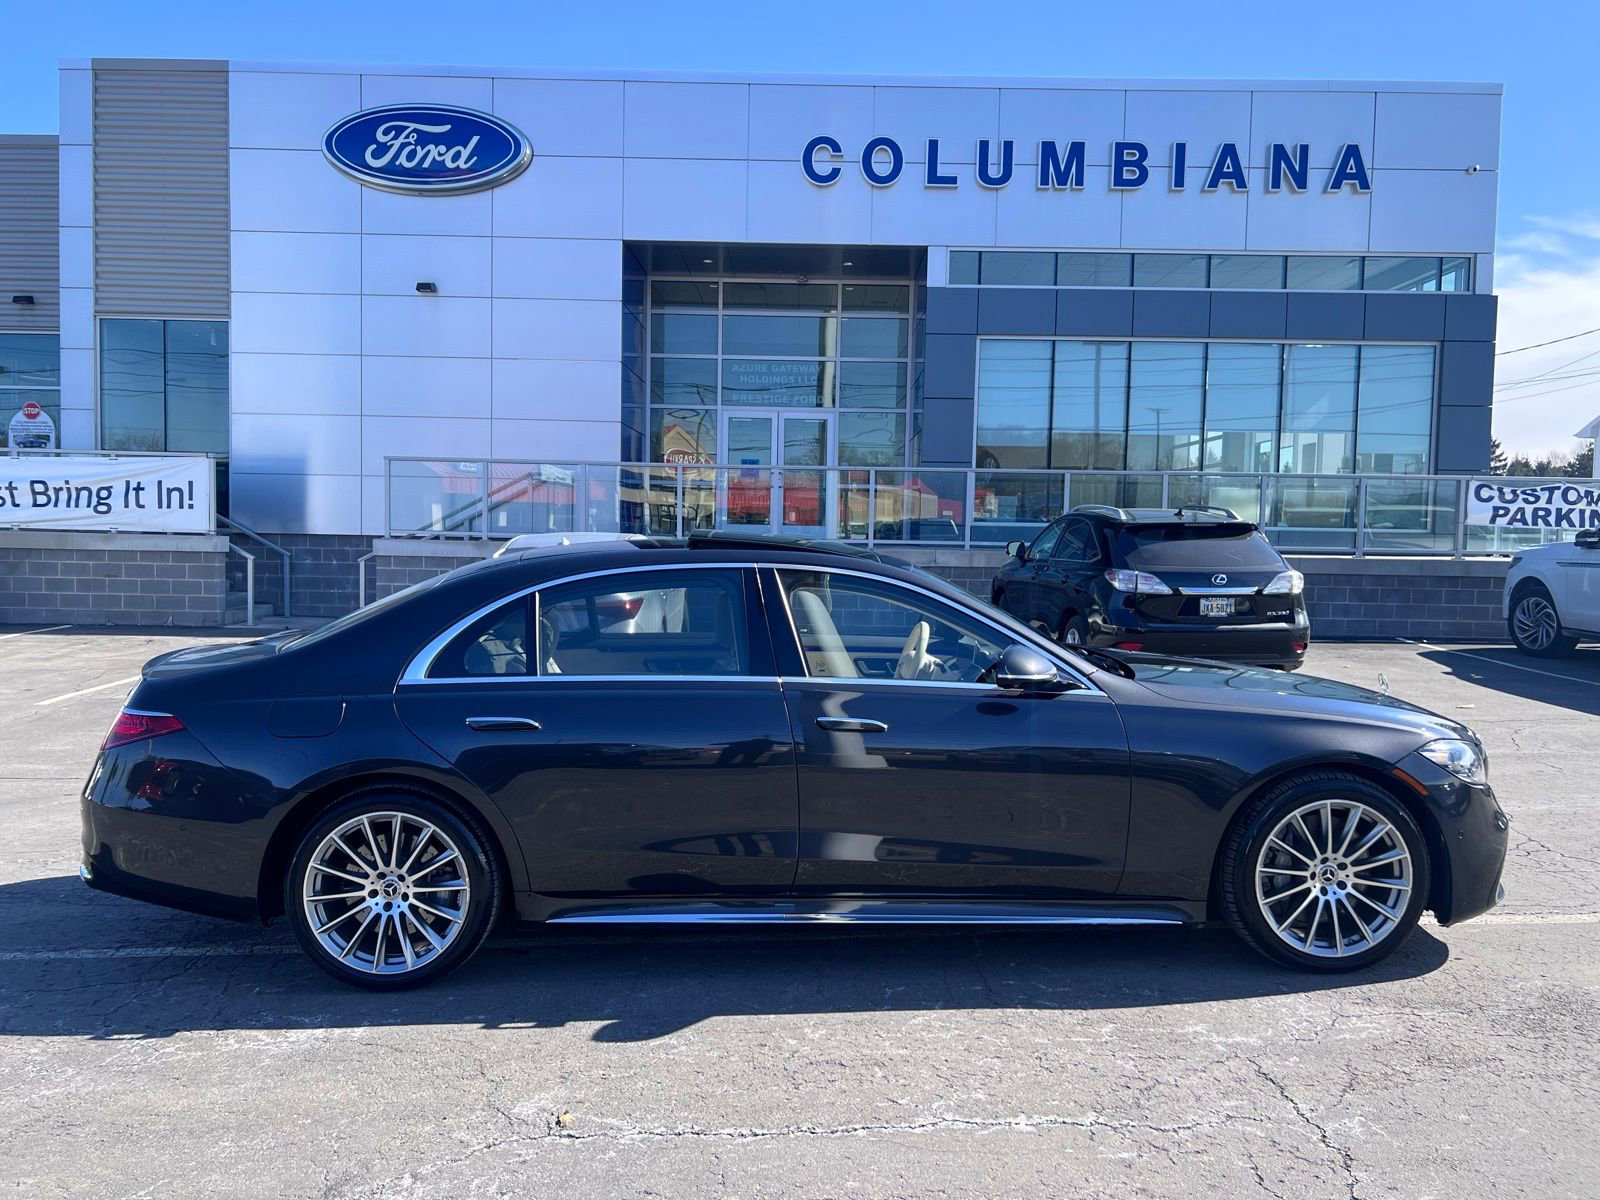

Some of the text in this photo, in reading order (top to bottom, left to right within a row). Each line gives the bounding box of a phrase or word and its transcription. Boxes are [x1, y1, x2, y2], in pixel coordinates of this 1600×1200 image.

[365, 121, 481, 169] Ford
[800, 133, 1373, 193] COLUMBIANA
[732, 363, 823, 373] AZURE GATEWAY
[739, 375, 795, 384] HOLDINGS
[732, 393, 825, 404] PRESTIGE FORD
[24, 407, 40, 415] STOP
[29, 479, 114, 515] Bring
[123, 479, 146, 509] It
[157, 479, 195, 510] In!
